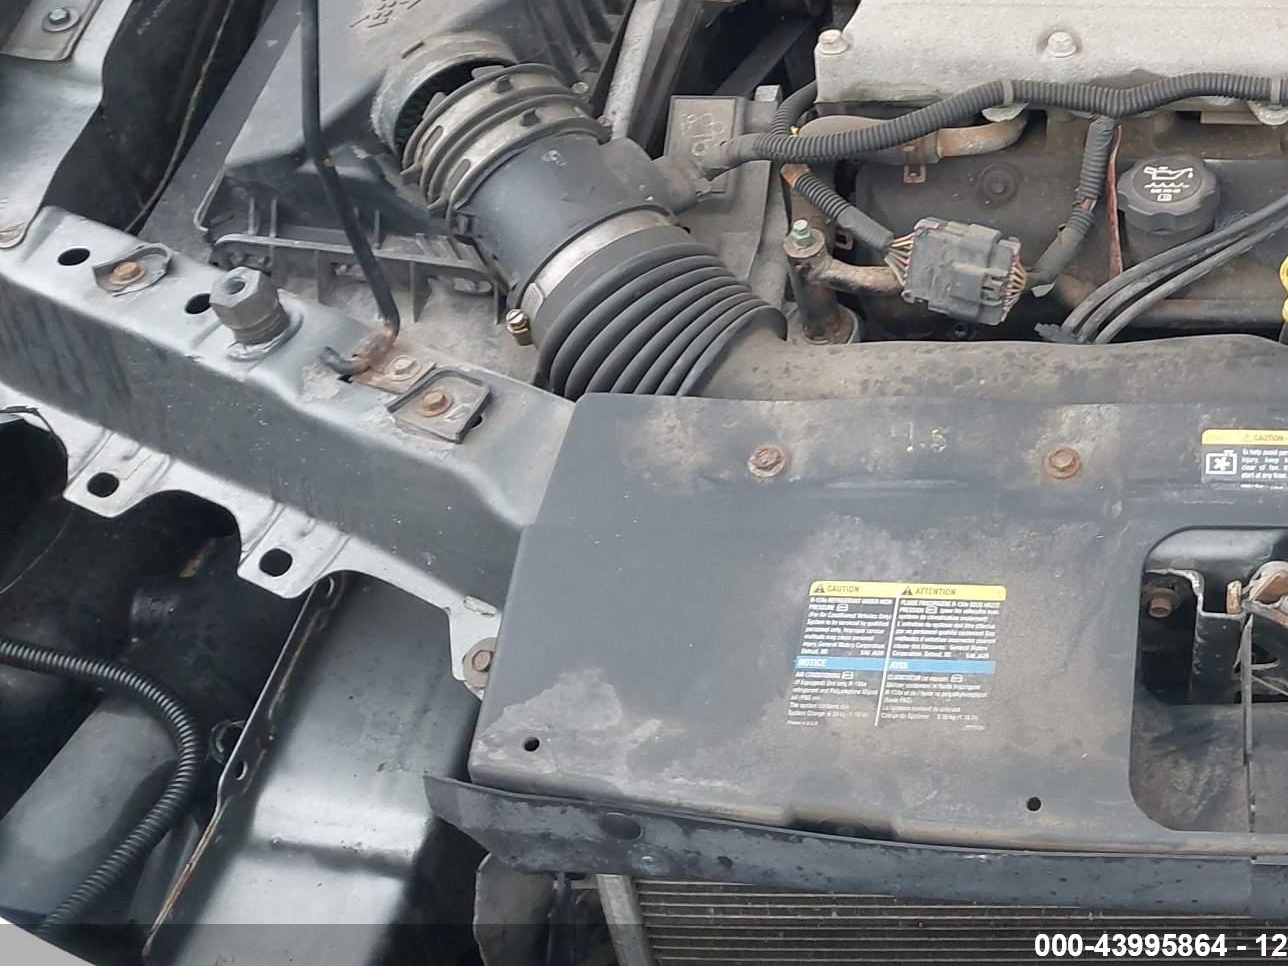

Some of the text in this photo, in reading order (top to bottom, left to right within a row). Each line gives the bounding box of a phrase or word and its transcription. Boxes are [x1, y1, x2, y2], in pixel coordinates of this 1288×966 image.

[1254, 434, 1284, 442] CAUTION
[827, 585, 860, 593] CAUTION
[915, 587, 956, 595] ATTENTION
[798, 658, 827, 666] NOTICE
[890, 662, 908, 670] AVIS
